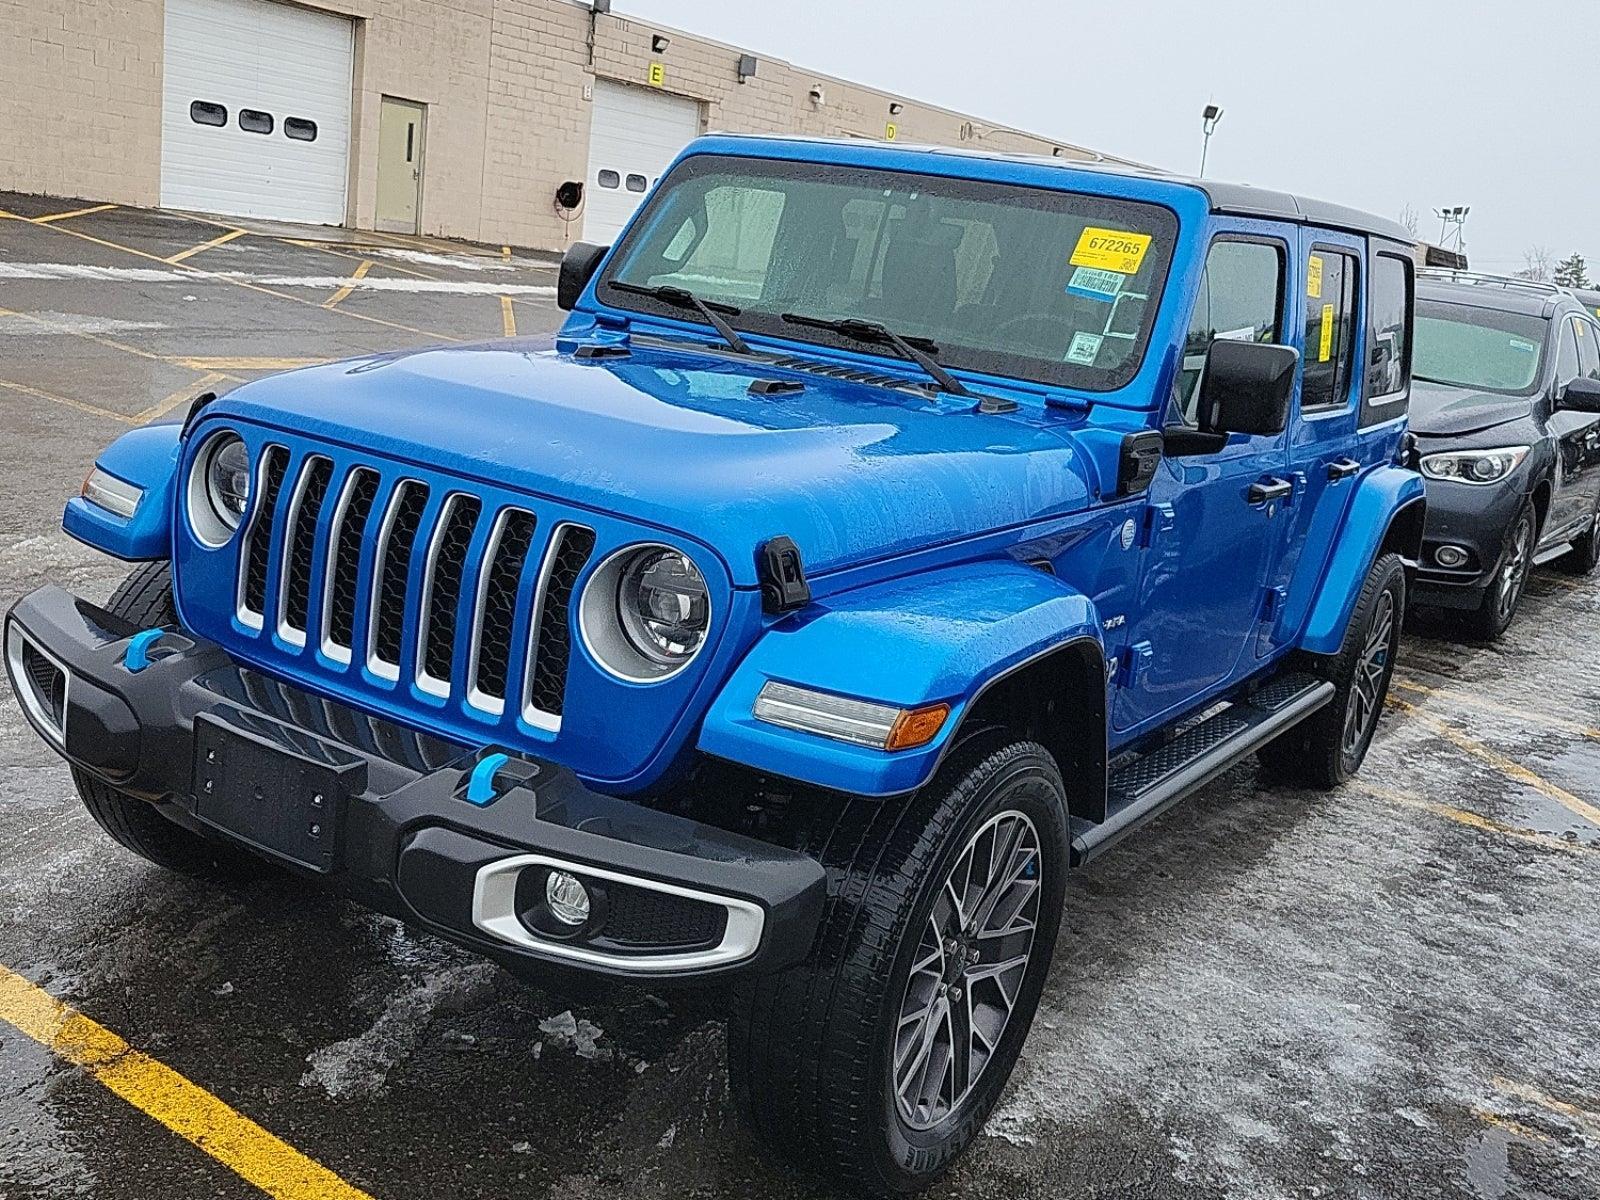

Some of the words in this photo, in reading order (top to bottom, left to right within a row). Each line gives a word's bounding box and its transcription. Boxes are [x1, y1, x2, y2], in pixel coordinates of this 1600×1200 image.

[652, 66, 661, 82] E
[887, 126, 895, 139] D
[1089, 237, 1141, 255] 672265
